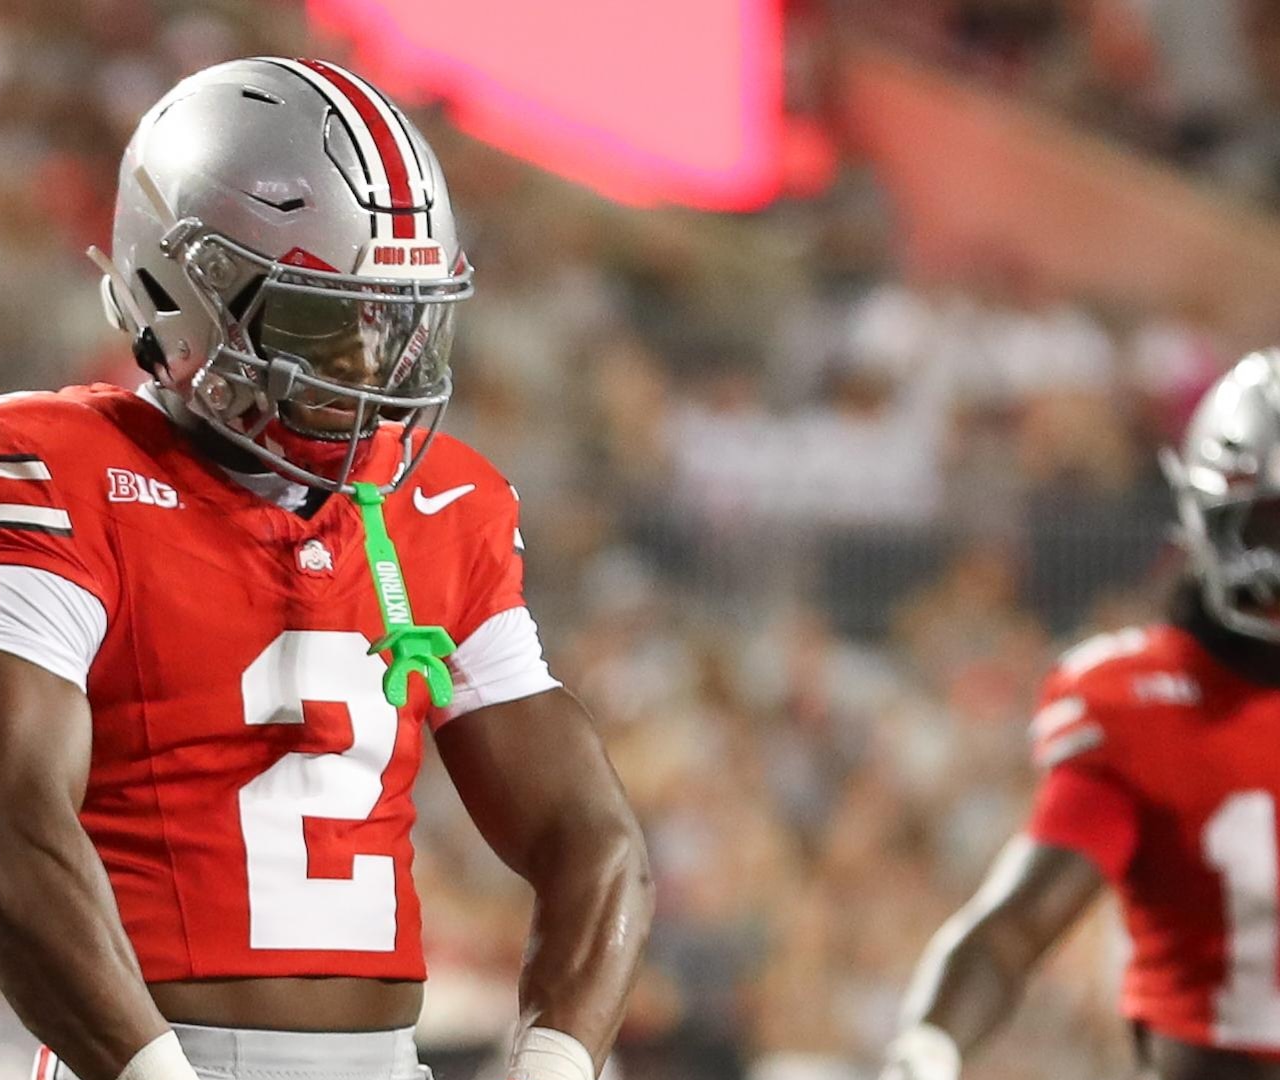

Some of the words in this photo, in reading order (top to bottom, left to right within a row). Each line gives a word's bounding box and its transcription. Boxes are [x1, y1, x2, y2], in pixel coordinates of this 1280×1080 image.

[374, 246, 404, 265] OHIO
[376, 561, 410, 624] NXTRND
[238, 631, 398, 952] 2
